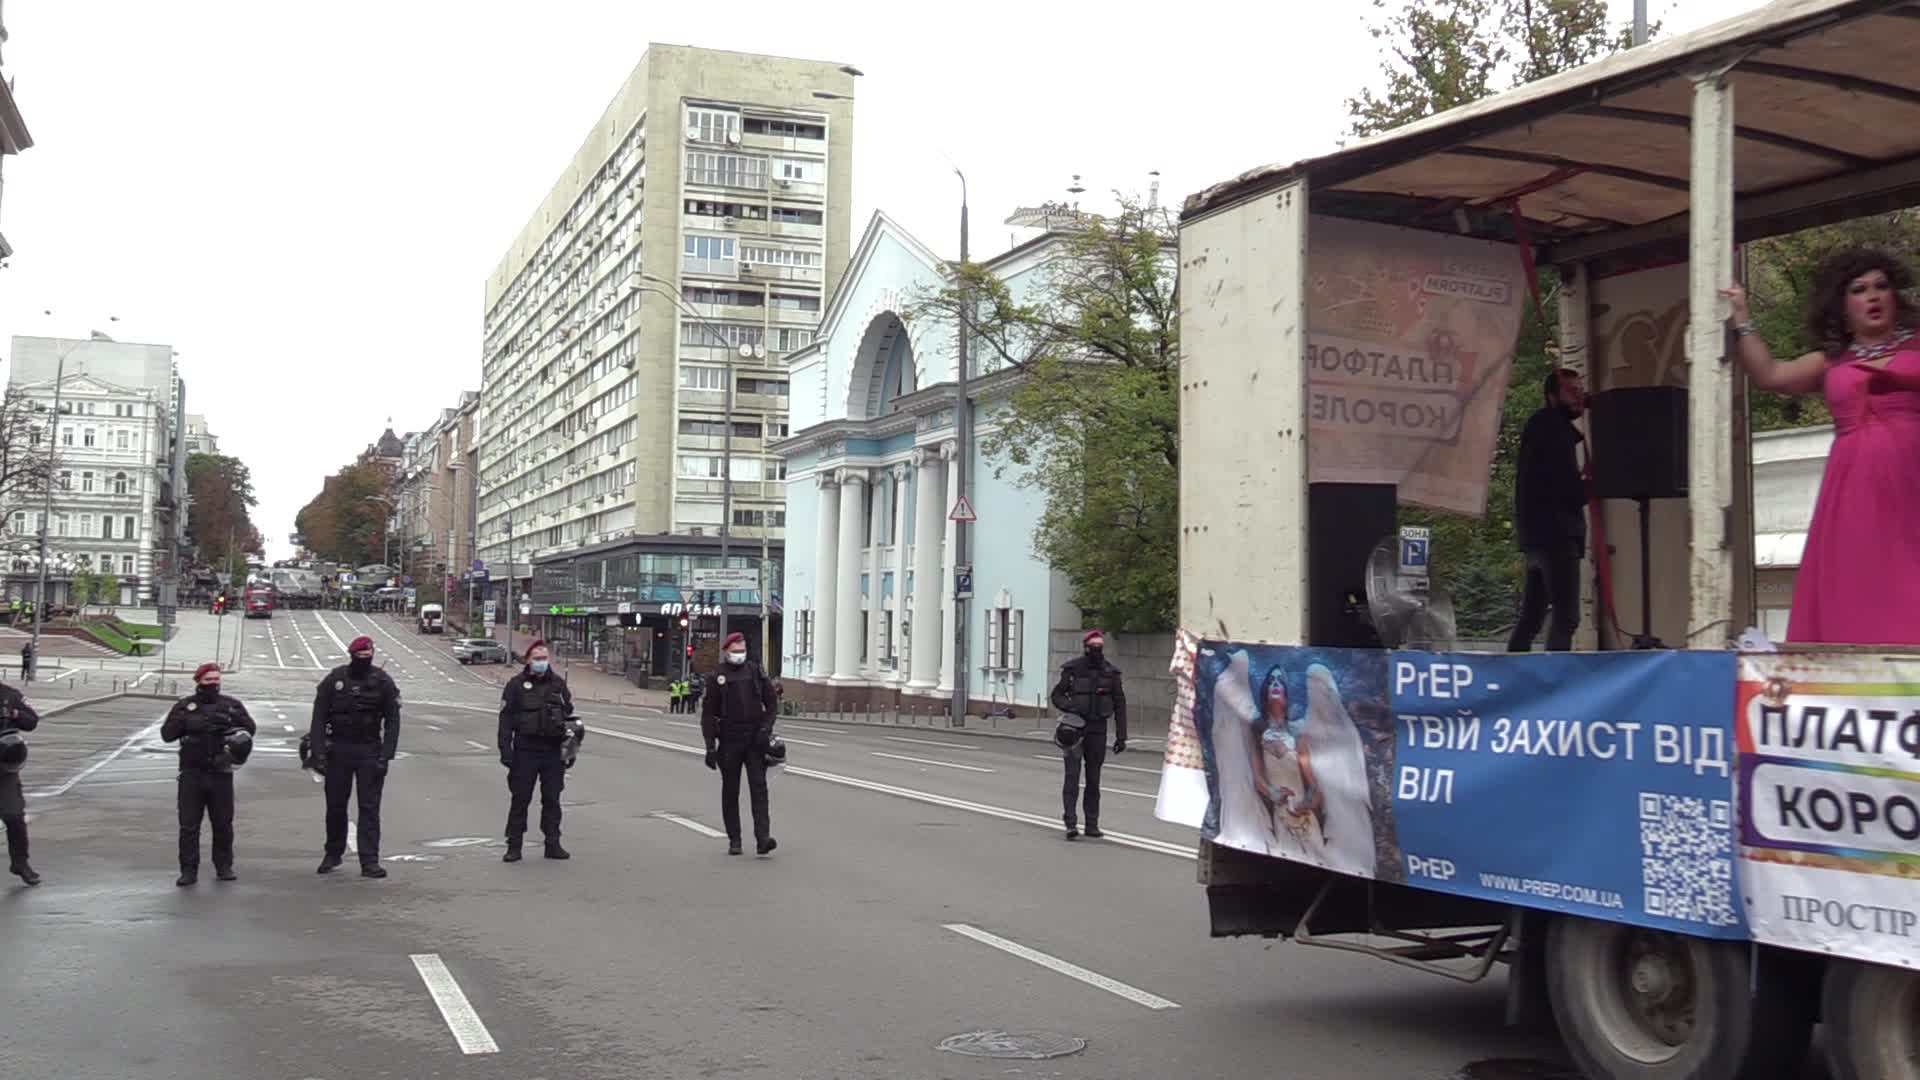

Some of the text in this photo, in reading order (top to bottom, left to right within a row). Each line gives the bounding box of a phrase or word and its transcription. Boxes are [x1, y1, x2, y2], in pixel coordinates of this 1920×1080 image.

[1401, 528, 1429, 538] ЗОНА
[660, 602, 722, 616] АПТЕКА
[1396, 662, 1473, 698] PrEP
[1397, 709, 1729, 778] ТВІЙ ЗАХИСТ ВІД
[1398, 766, 1455, 803] ВІЛ
[1775, 784, 1920, 840] КОРО
[1408, 854, 1624, 909] PrEP WWW.PREP.COM.UA
[1781, 894, 1917, 937] ПРОСТІР
